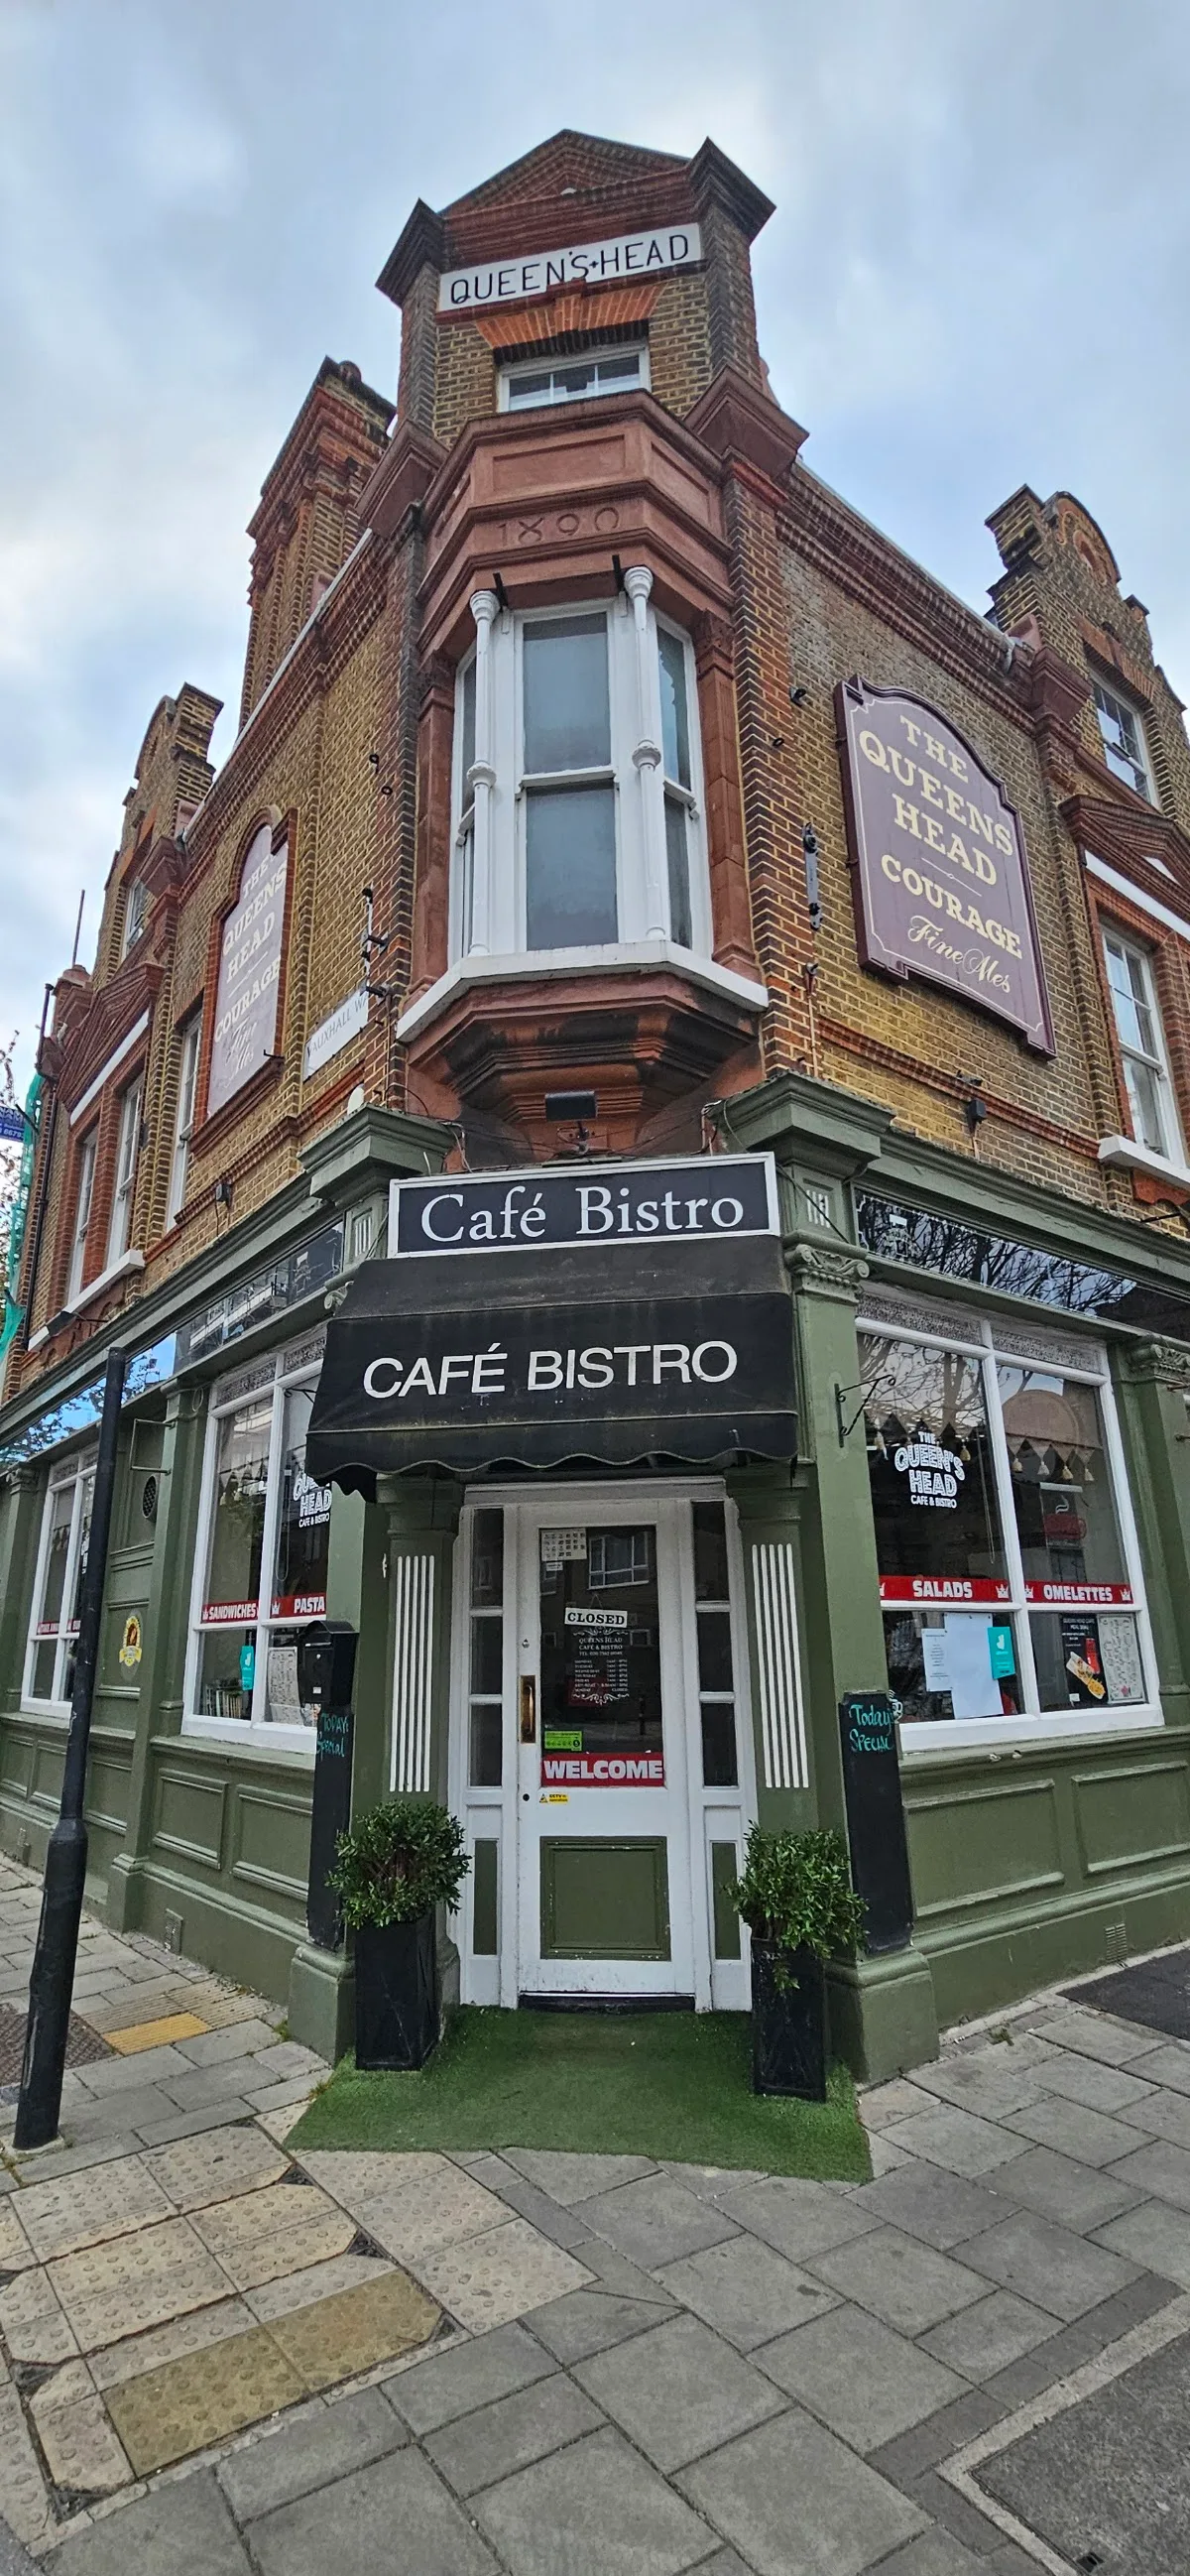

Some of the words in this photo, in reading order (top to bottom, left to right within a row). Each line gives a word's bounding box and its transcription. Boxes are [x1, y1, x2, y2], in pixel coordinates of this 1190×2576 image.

[451, 251, 590, 306] QUEEN'S
[600, 233, 689, 277] HEAD
[497, 506, 621, 548] 1890
[898, 714, 969, 783] THE
[858, 729, 1013, 857] QUEENS
[892, 793, 998, 887] HEAD
[243, 859, 269, 899] THE
[222, 860, 287, 955] QUEENS
[881, 854, 1022, 960] COURAGE
[226, 912, 276, 983] HEAD
[906, 914, 964, 966] Fine
[963, 947, 1012, 994] Ales
[214, 955, 281, 1043] COURAGE
[307, 1009, 351, 1058] VAUXHALL
[420, 1184, 547, 1244] Café
[575, 1185, 744, 1236] Bistro
[363, 1342, 508, 1400] CAFÉ
[527, 1340, 738, 1391] BISTRO
[917, 1430, 936, 1444] THE
[893, 1443, 966, 1481] QUEEN'S
[299, 1489, 332, 1518] HEAD
[908, 1469, 958, 1497] HEAD
[910, 1495, 928, 1506] CAFE
[929, 1496, 935, 1507] &
[935, 1497, 958, 1509] BISTRO
[314, 1513, 330, 1525] BISTRO
[294, 1596, 325, 1614] PASTA
[912, 1580, 973, 1600] SALADS
[1043, 1585, 1113, 1602] OMELETTES
[208, 1602, 257, 1621] SANDWICHES
[567, 1612, 625, 1625] CLOSED
[543, 1760, 663, 1779] WELCOME
